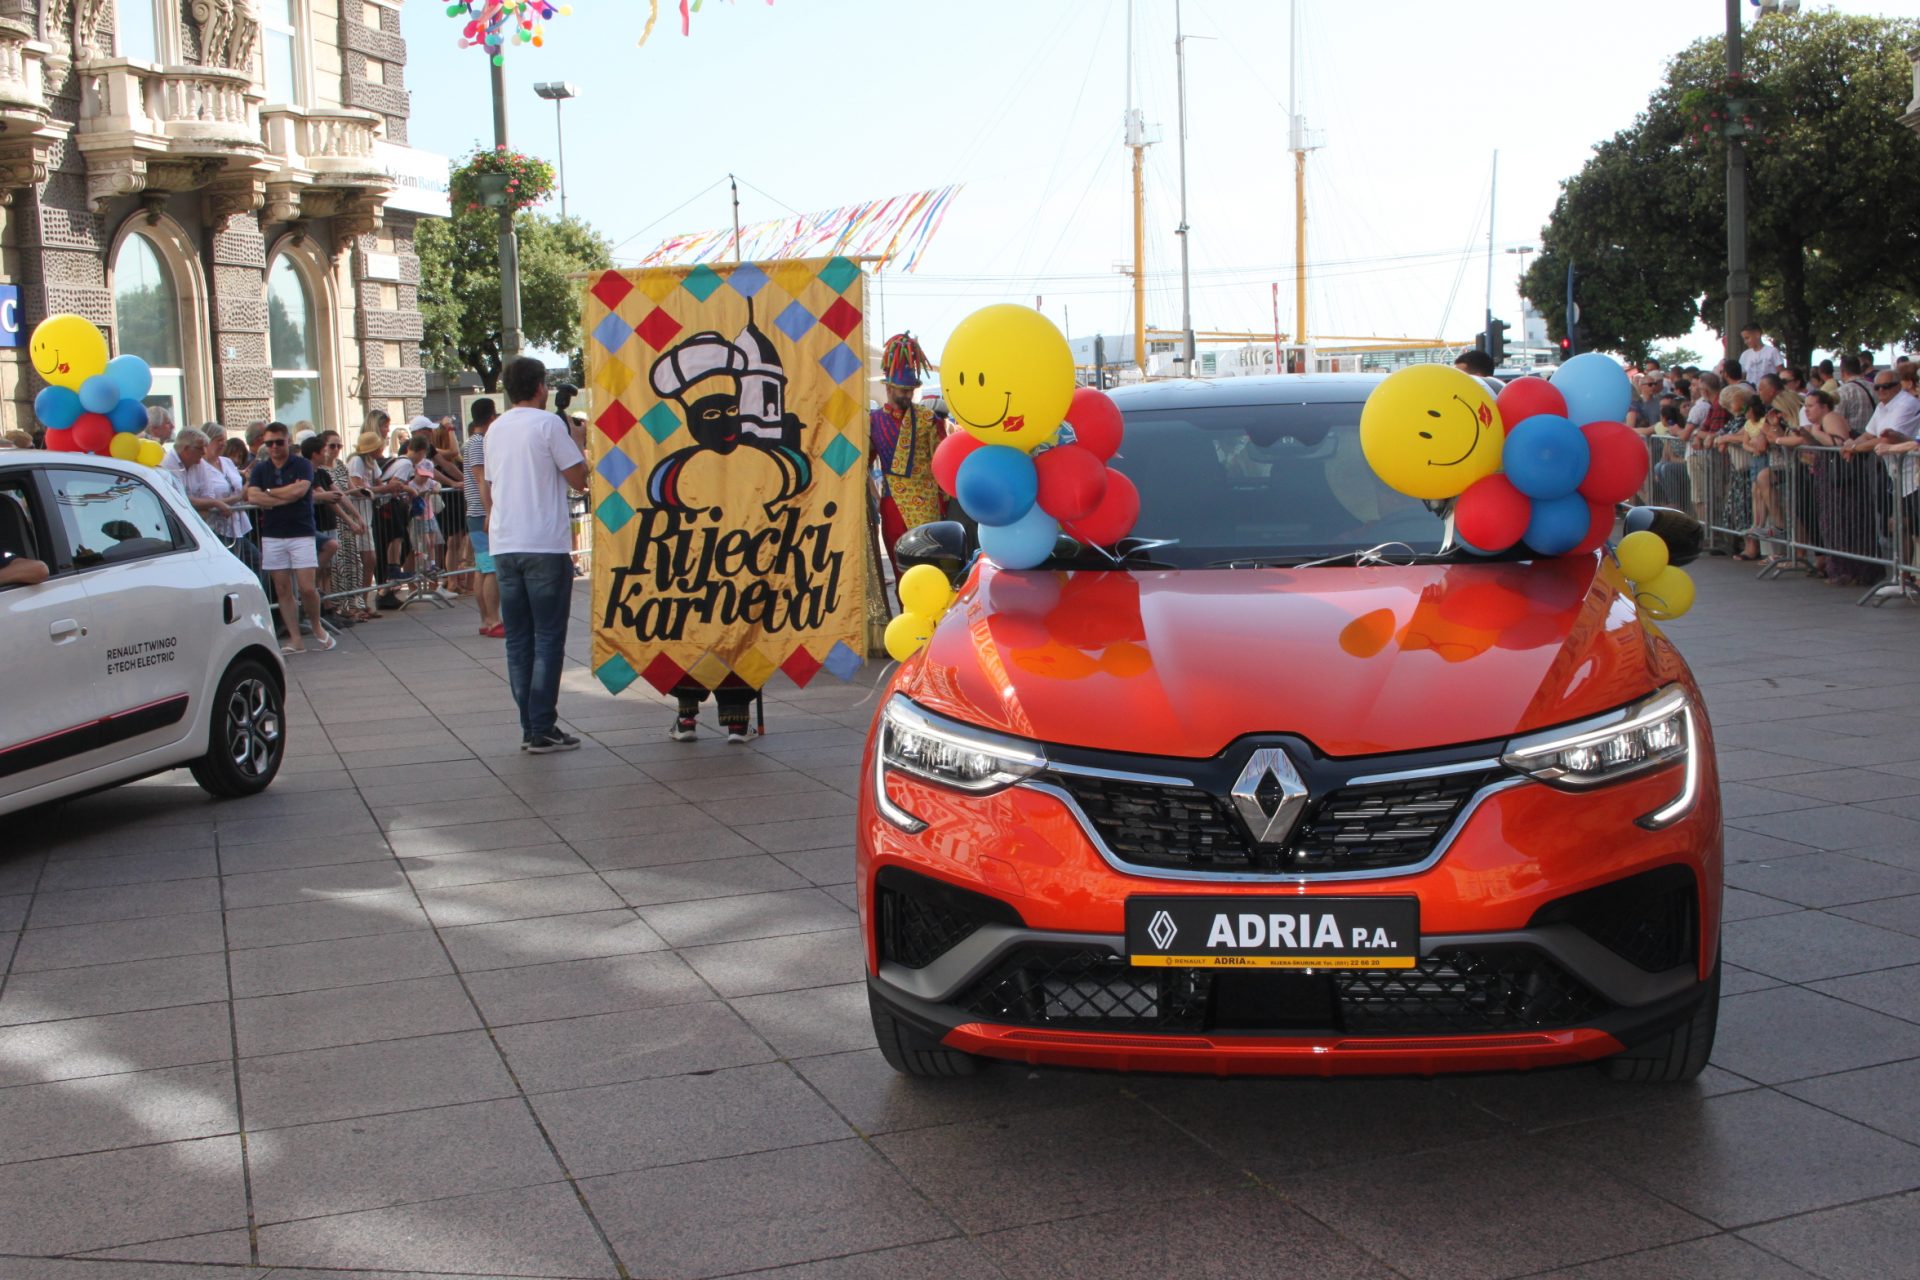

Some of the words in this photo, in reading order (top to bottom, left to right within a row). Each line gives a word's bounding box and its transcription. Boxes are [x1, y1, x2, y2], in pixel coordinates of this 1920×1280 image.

[107, 643, 143, 660] RENAULT
[144, 637, 177, 652] TWINGO
[107, 661, 136, 675] E-TECH
[137, 651, 175, 668] ELECTRIC
[1206, 914, 1344, 948] ADRIA
[1352, 927, 1397, 948] P.A.
[1214, 957, 1247, 965] ADRIA
